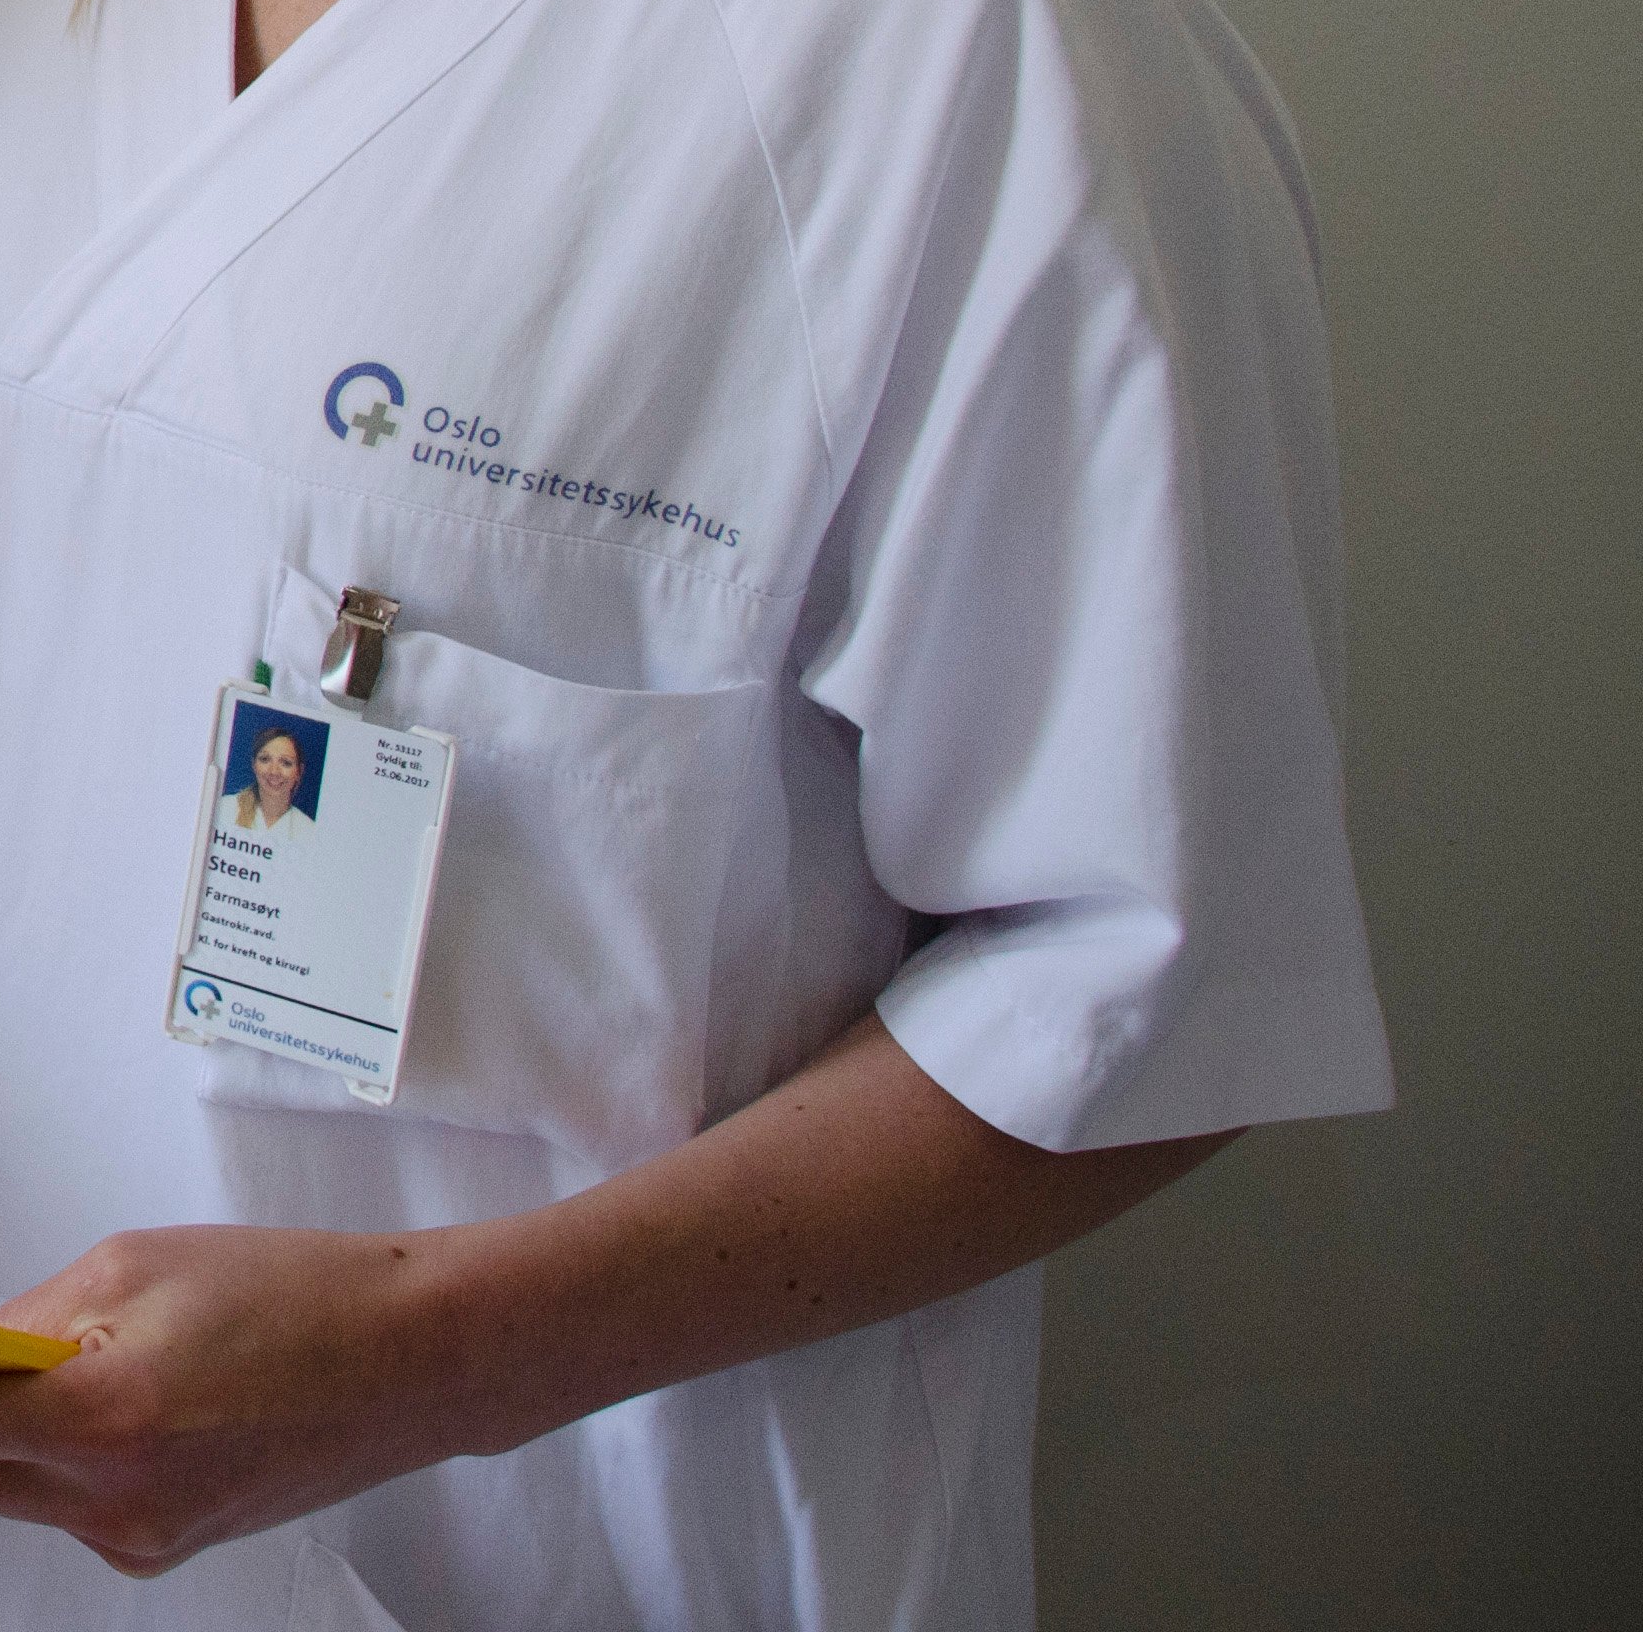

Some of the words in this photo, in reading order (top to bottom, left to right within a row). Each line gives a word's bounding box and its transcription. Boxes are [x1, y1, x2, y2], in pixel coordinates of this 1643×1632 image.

[422, 405, 502, 448] Oslo
[411, 441, 741, 549] universitetssykehus
[377, 738, 393, 751] Nr.
[375, 752, 407, 769] Gyldig
[374, 766, 430, 788] 25.06.2017
[213, 829, 274, 860] Hanne
[207, 855, 262, 884] Steen
[205, 886, 281, 919] Farmasøyt
[213, 938, 229, 950] for
[231, 943, 258, 960] kreft
[259, 954, 273, 966] og
[275, 956, 310, 976] kirurgi
[231, 1001, 265, 1023] Oslo
[228, 1018, 381, 1074] universitetssykehus
